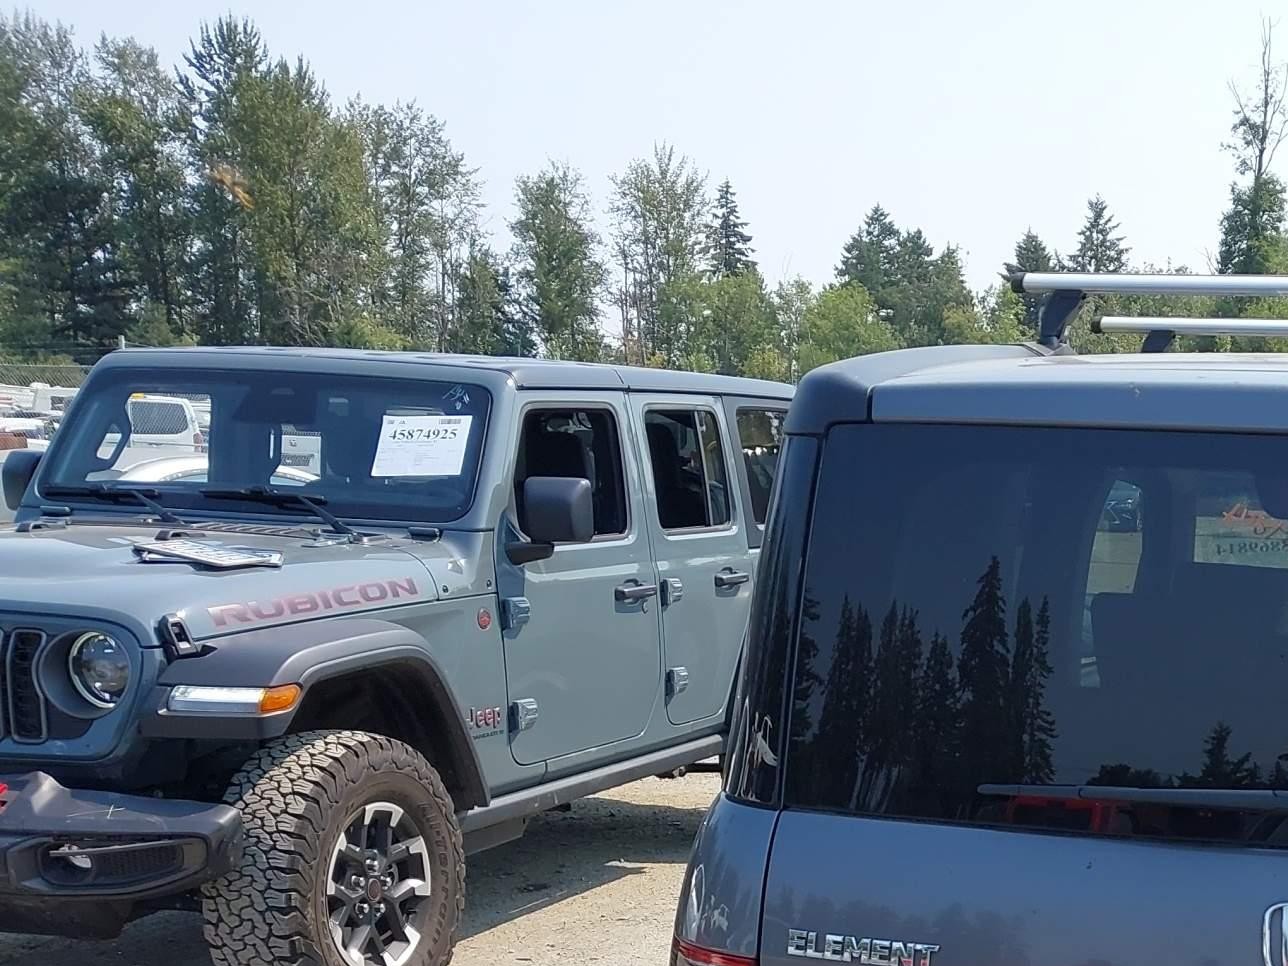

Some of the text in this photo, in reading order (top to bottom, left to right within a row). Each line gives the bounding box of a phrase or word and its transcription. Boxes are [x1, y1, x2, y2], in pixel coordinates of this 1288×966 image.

[388, 428, 458, 440] 45874925
[208, 577, 419, 627] RUBICON
[465, 706, 501, 729] Jeep
